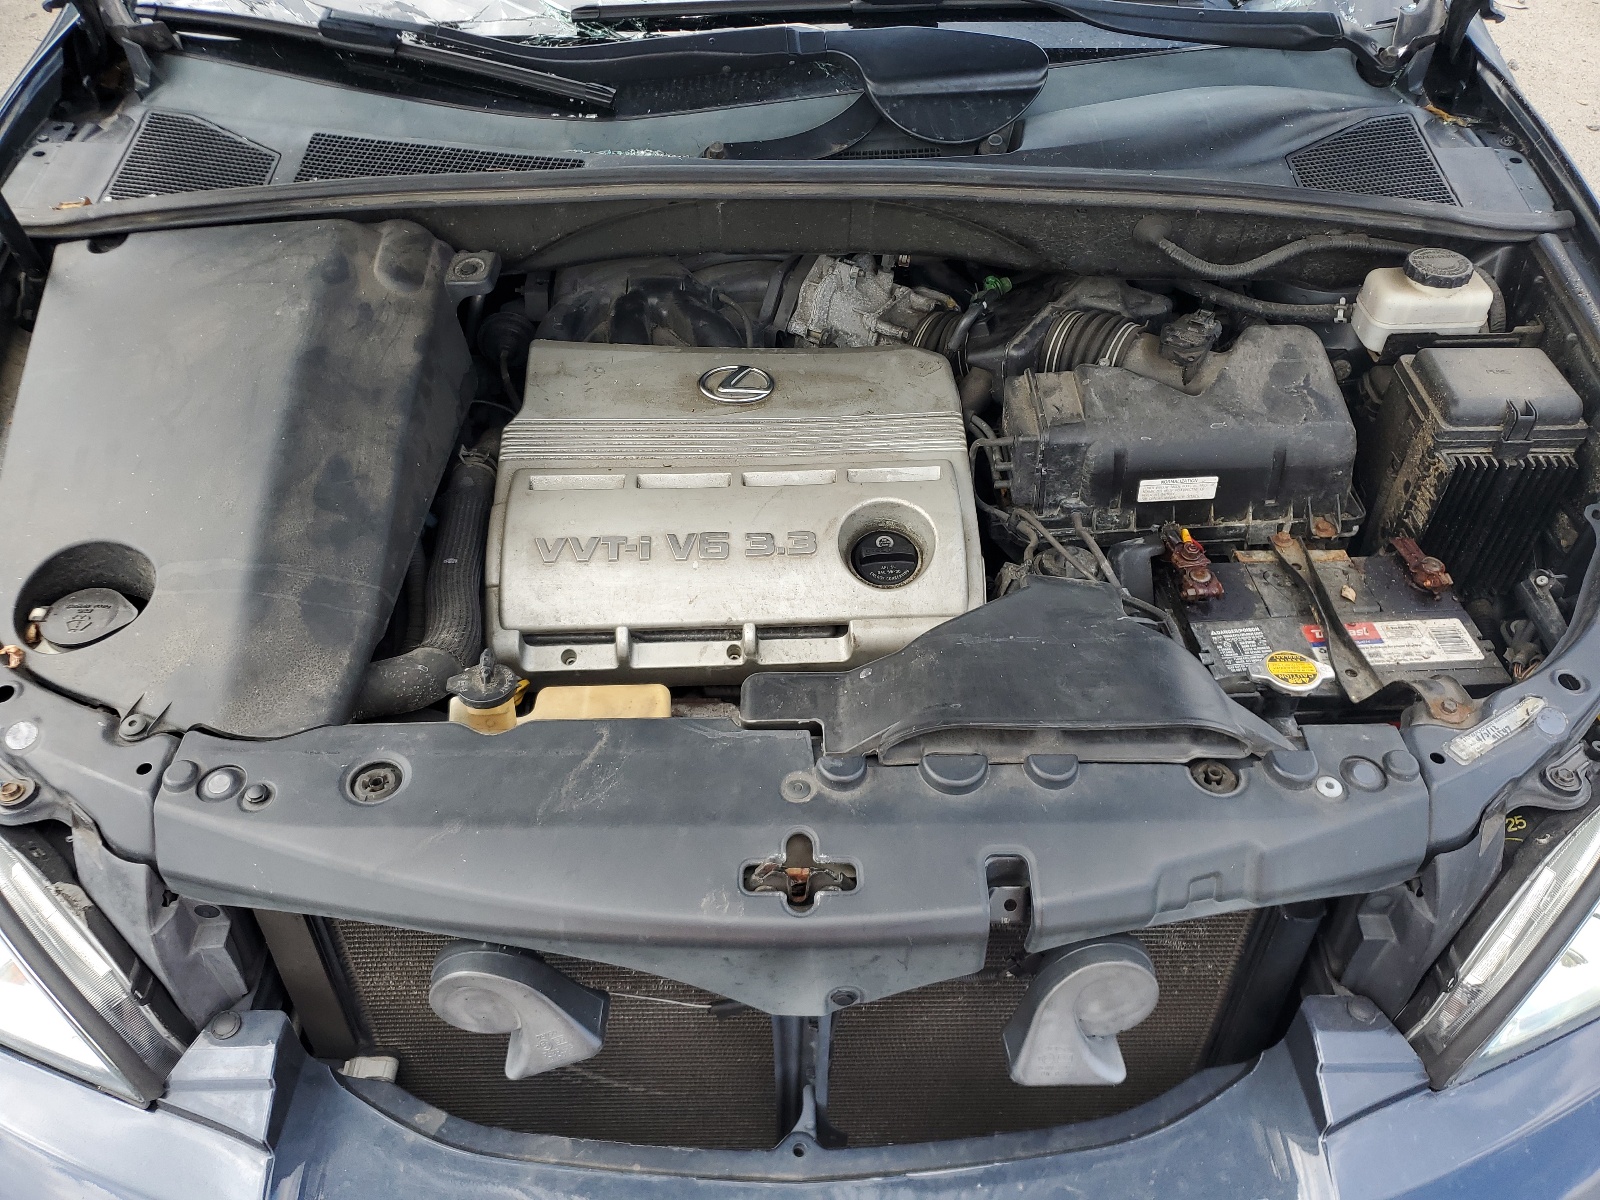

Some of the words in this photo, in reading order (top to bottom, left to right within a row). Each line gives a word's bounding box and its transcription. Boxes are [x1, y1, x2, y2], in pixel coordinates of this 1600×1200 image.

[535, 535, 652, 564] VVT-i
[666, 531, 730, 561] V6
[744, 530, 818, 557] 3.3
[1505, 815, 1527, 832] 25
